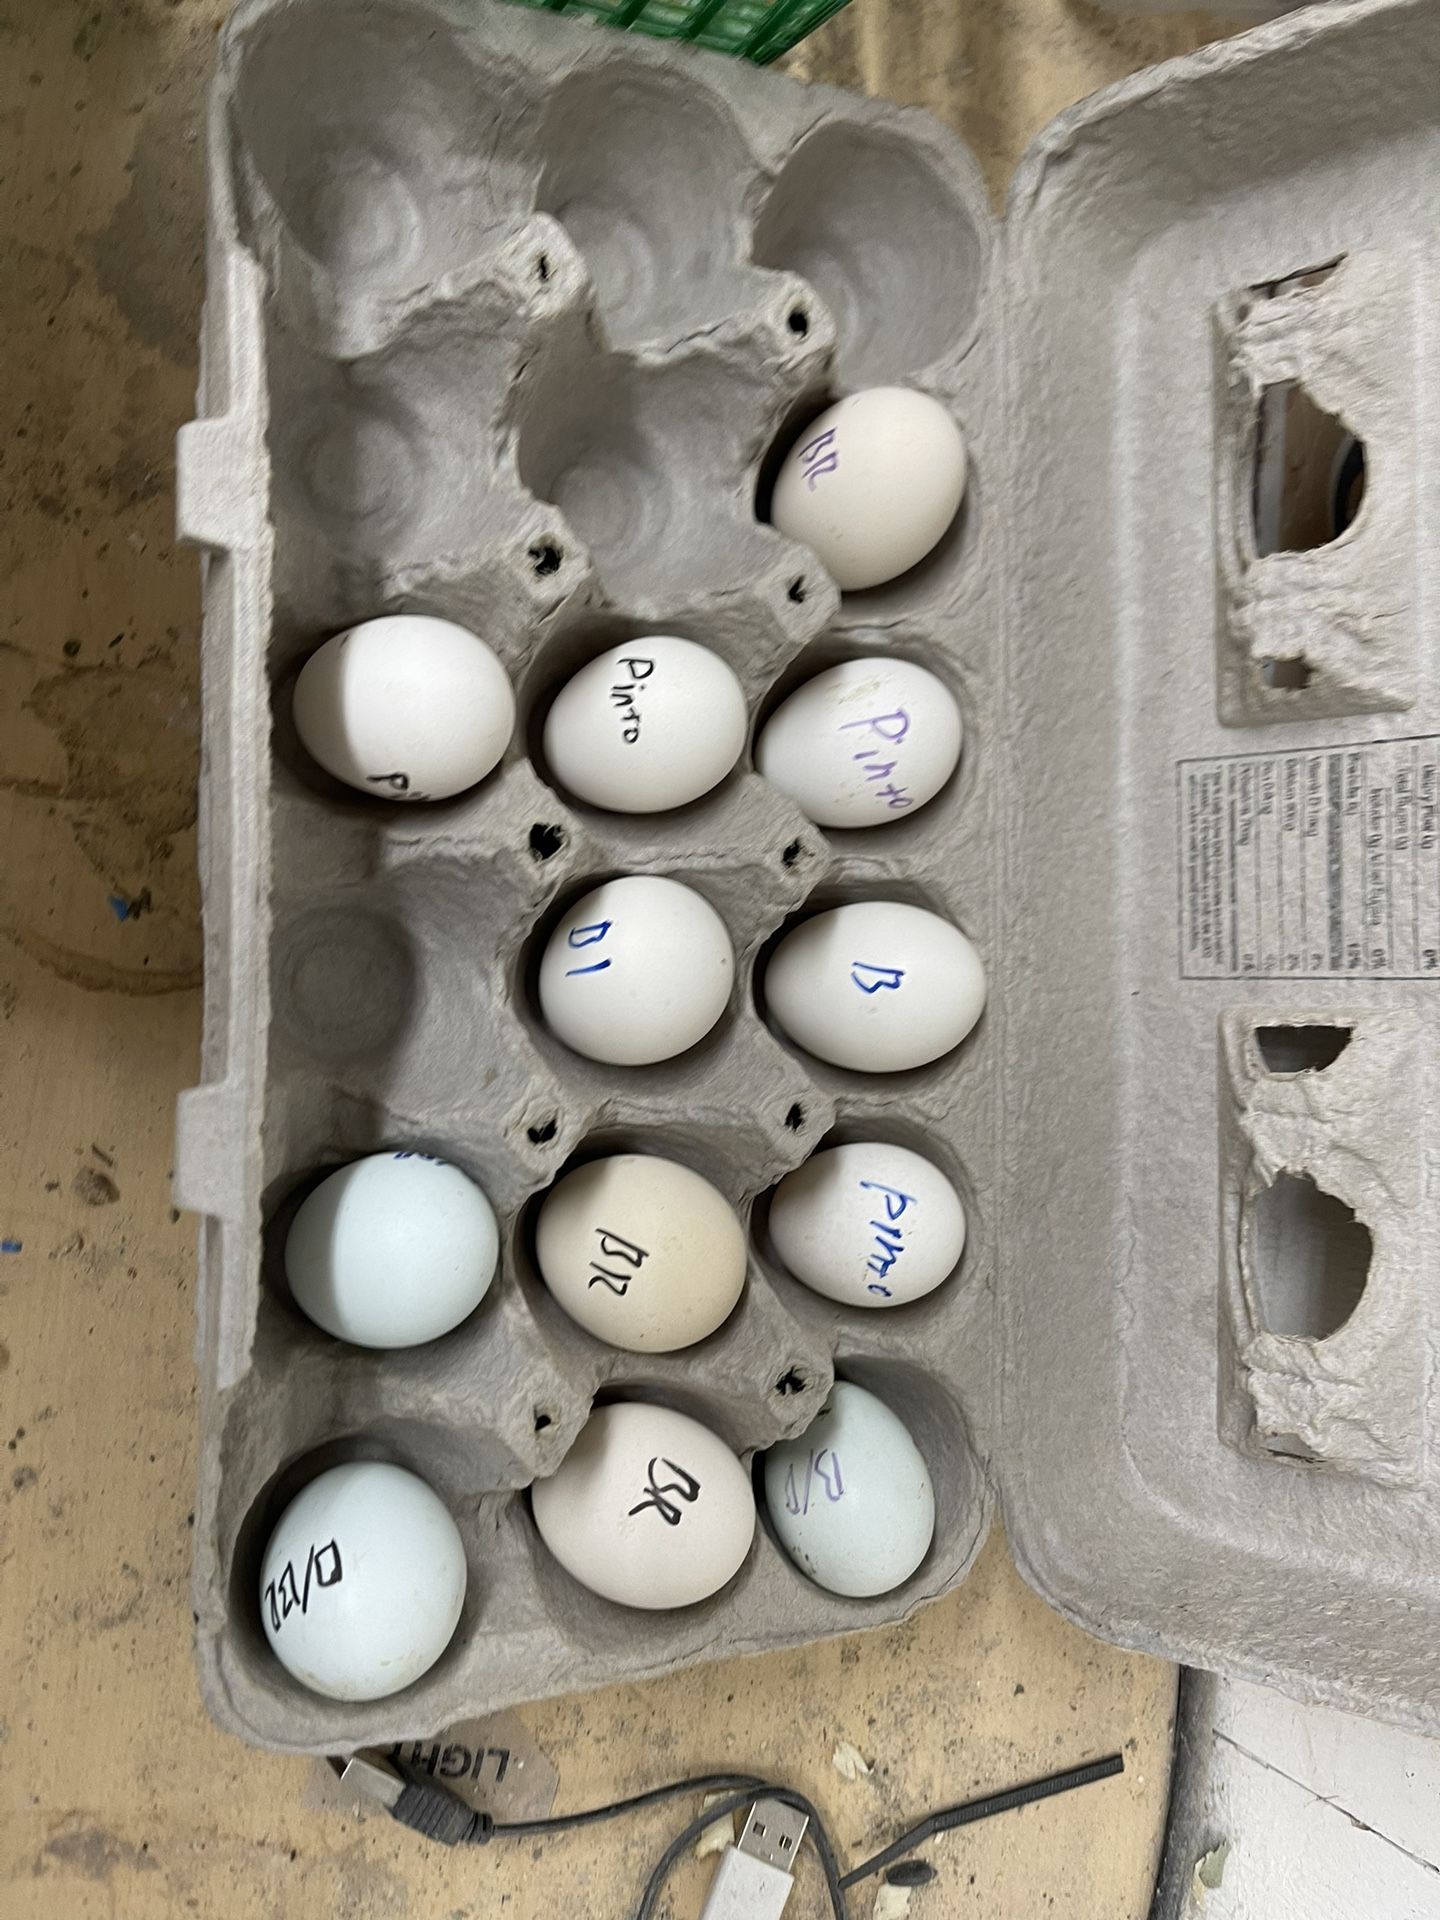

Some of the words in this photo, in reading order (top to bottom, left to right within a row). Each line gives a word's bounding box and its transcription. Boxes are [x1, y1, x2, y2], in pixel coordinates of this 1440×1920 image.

[610, 657, 655, 745] Pinto
[838, 708, 914, 811] Pinto
[588, 1228, 650, 1298] BR
[628, 1456, 702, 1526] BR
